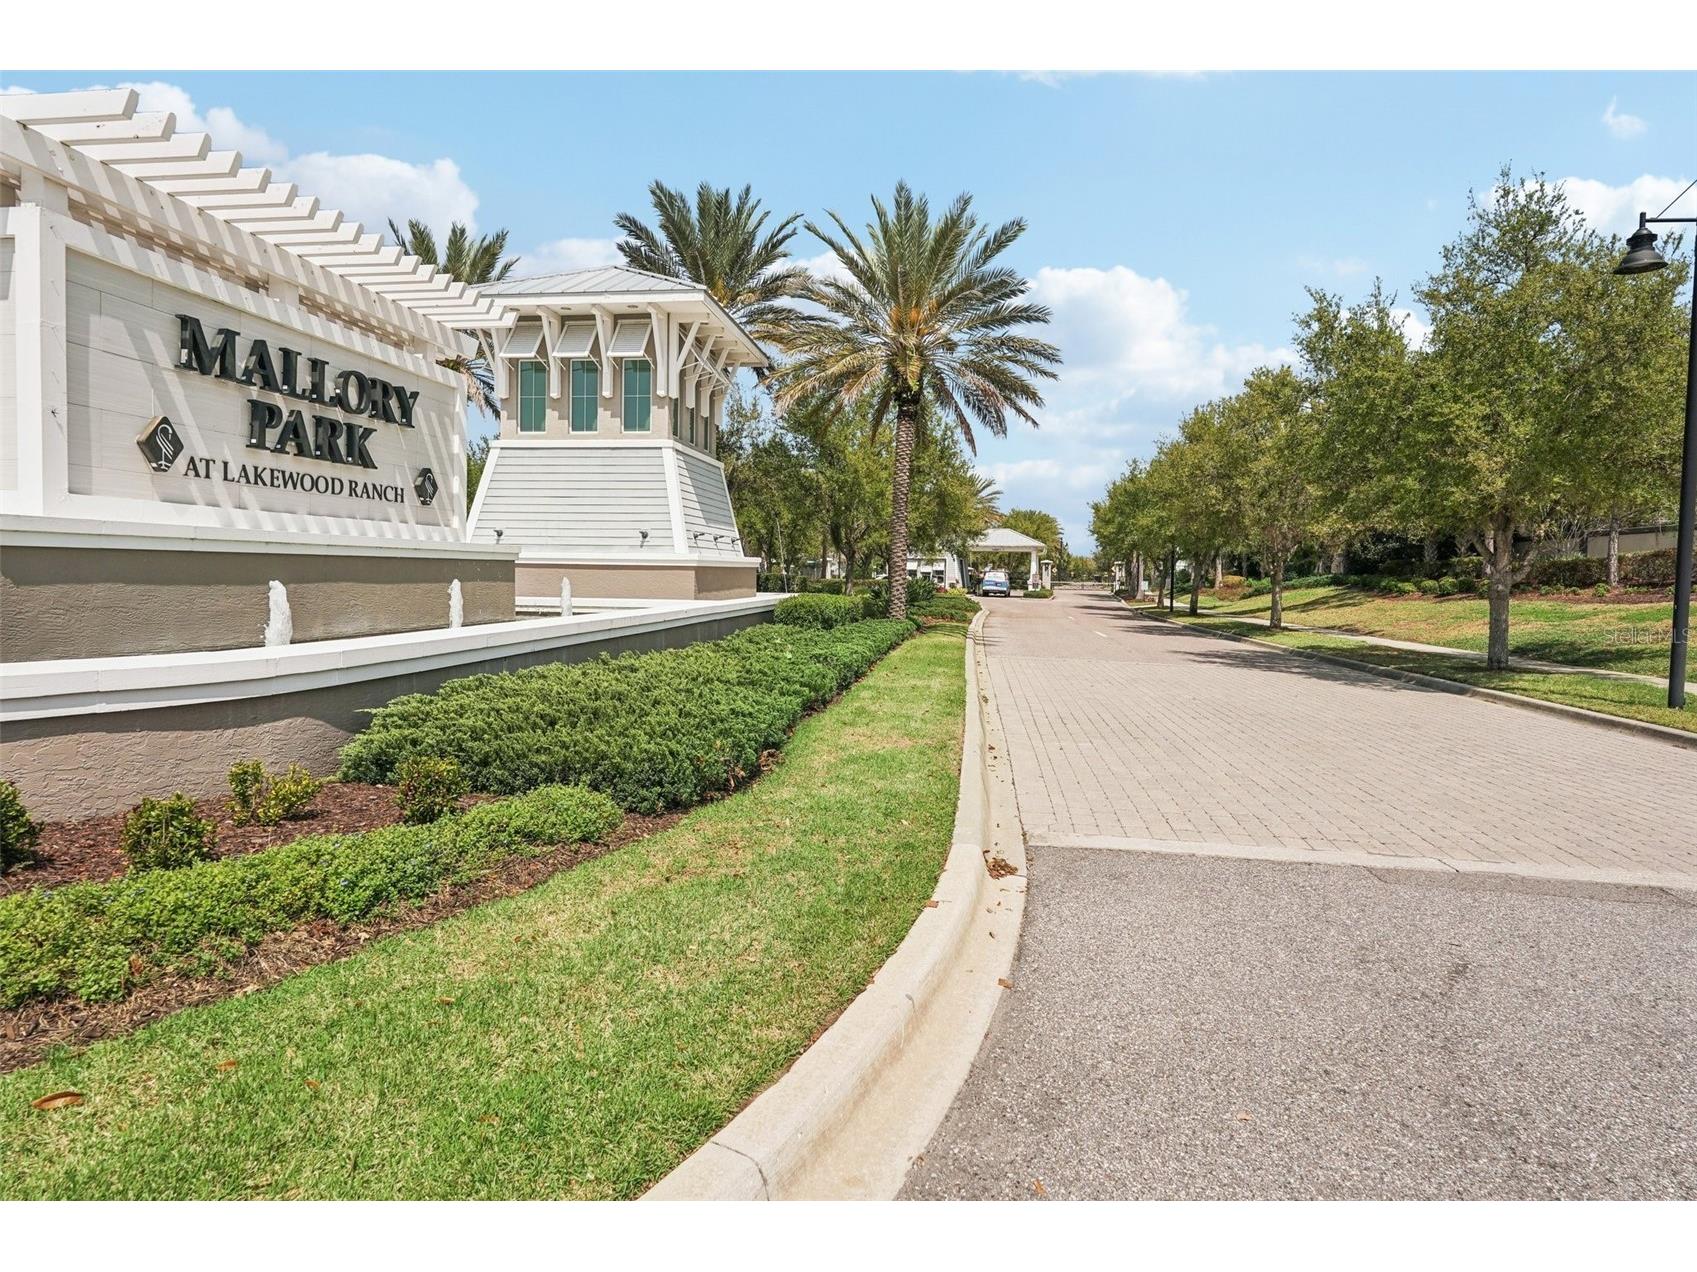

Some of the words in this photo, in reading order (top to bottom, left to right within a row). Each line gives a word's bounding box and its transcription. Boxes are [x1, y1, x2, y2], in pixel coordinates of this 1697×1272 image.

[175, 314, 419, 428] MALLORY
[246, 399, 378, 469] PARK
[184, 456, 215, 479] AT
[223, 461, 344, 495] LAKEWOOD
[348, 481, 405, 503] RANCH
